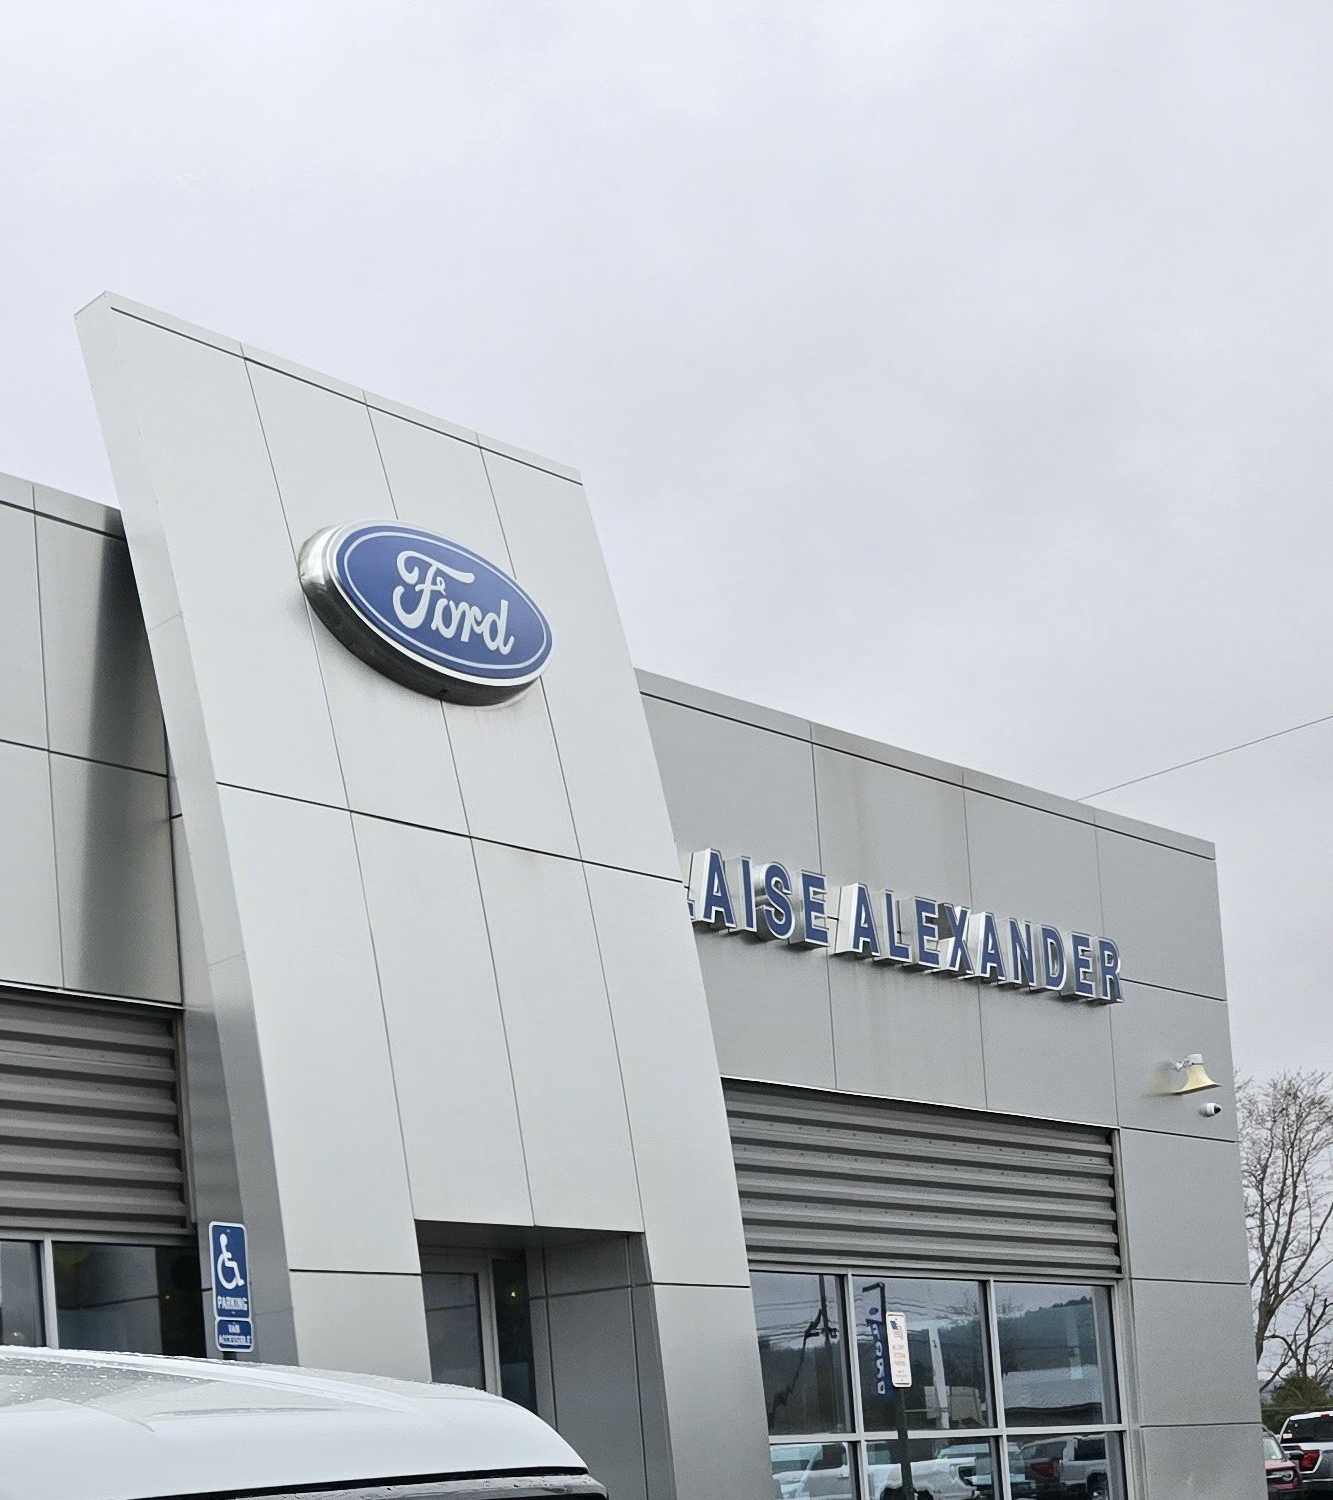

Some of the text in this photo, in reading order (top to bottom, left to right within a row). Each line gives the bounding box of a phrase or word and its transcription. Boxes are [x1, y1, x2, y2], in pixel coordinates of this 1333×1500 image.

[393, 550, 515, 655] Ford
[687, 848, 1124, 1004] AISE ALEXANDER
